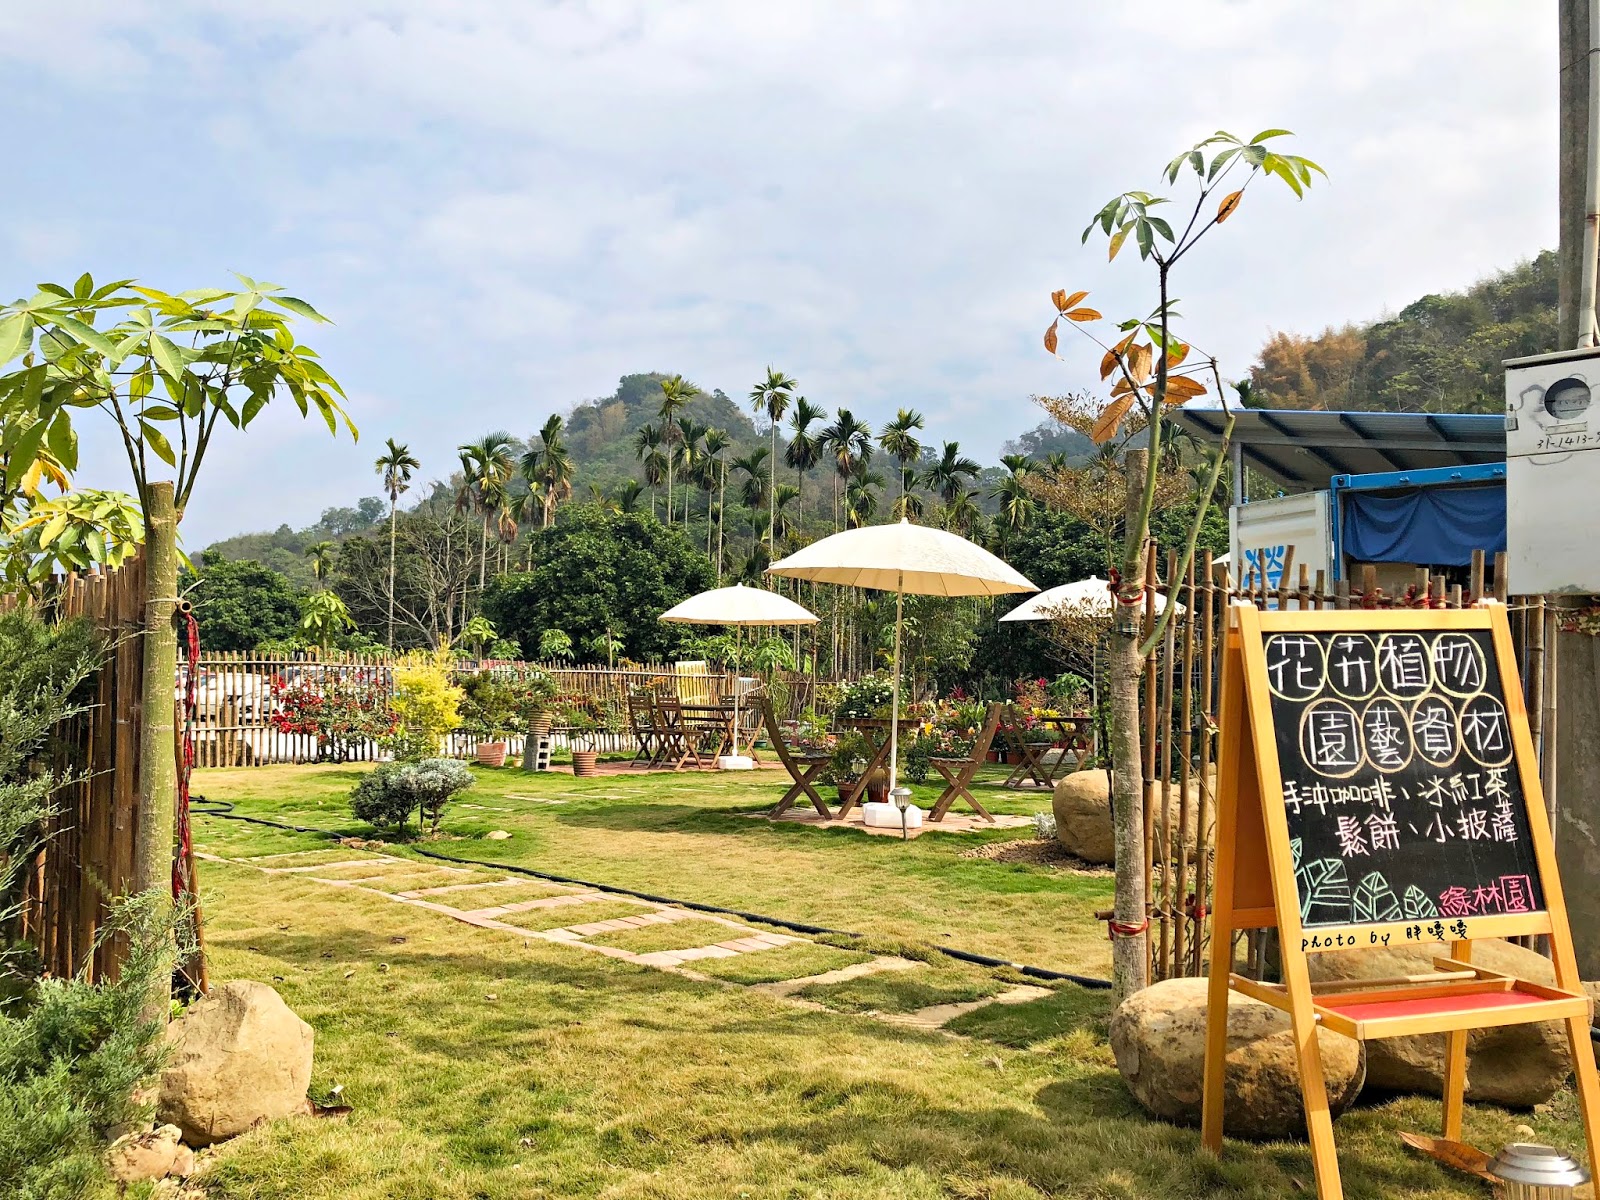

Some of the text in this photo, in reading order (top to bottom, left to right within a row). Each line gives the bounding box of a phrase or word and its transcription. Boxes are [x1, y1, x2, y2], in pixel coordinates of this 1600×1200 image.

[1269, 636, 1480, 692] 花卉植物
[1308, 703, 1504, 766] 園藝資材
[1438, 874, 1536, 917] 綠林園
